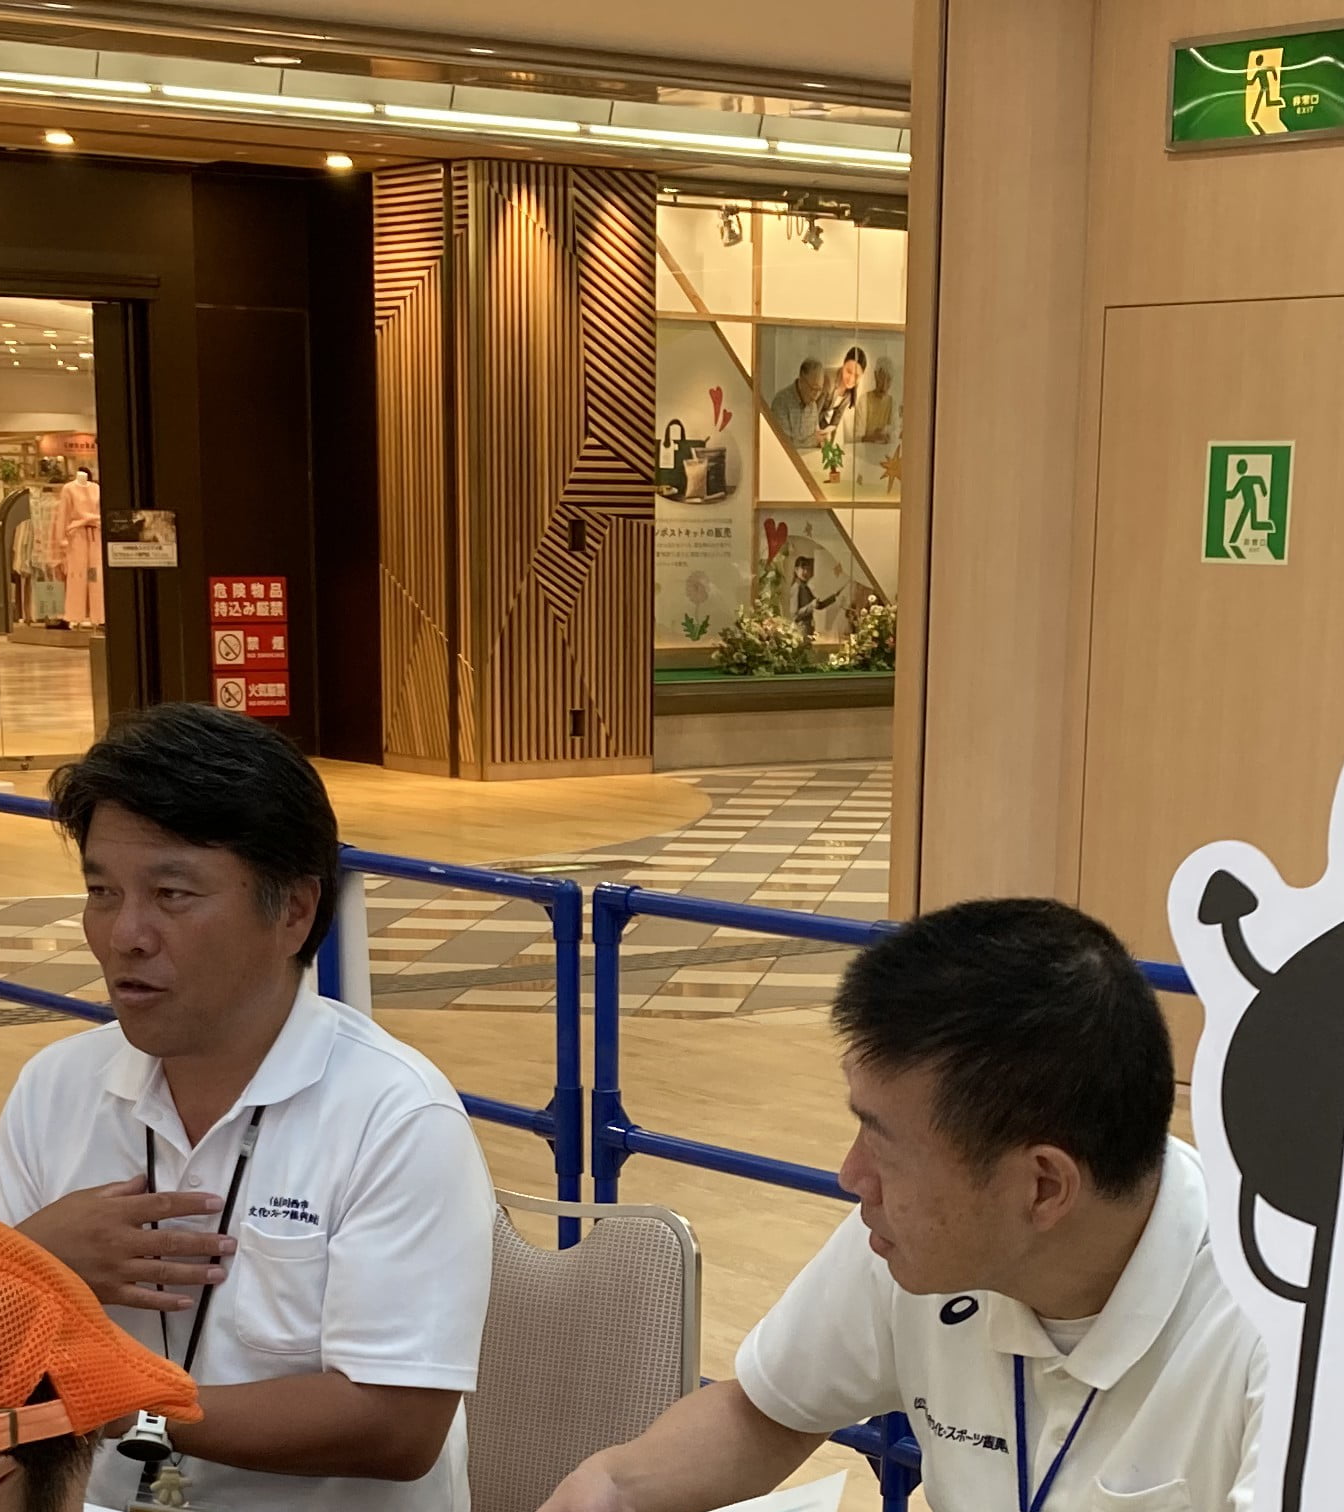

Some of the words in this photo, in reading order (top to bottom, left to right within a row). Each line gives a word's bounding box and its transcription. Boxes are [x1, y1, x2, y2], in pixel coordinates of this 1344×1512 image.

[213, 583, 283, 598] 危険物品
[214, 601, 284, 616] 持込み厳禁
